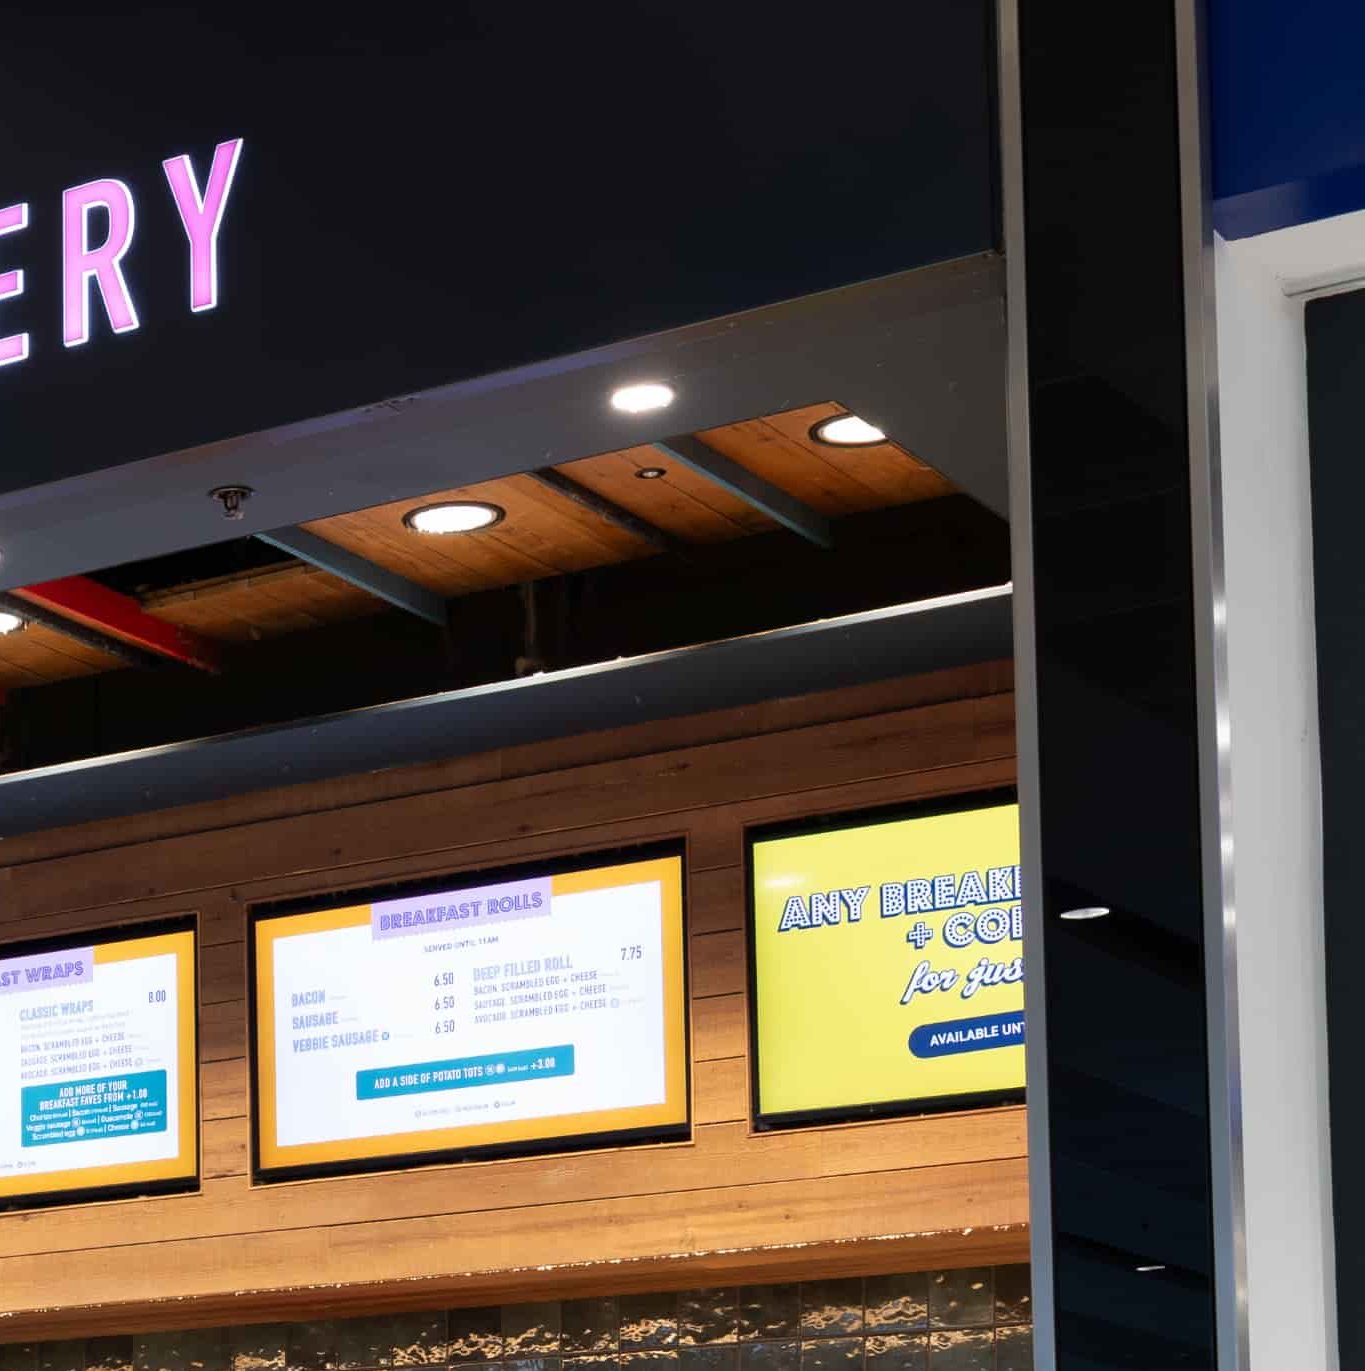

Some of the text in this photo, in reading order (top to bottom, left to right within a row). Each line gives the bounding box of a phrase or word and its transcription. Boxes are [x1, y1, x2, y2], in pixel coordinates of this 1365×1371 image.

[380, 891, 543, 931] BREAKFAST ROLLS
[778, 885, 870, 931] ANY
[907, 922, 933, 949] +
[25, 961, 84, 984] WRAPS
[473, 945, 642, 982] DEEP FILLED ROLL 7.75
[292, 972, 454, 1008] BACON 6.50
[900, 960, 959, 1005] for
[21, 1004, 57, 1021] CLASSIC
[60, 1000, 93, 1016] WRAPS
[293, 996, 455, 1030] SAUSAGE 6.50
[331, 1030, 379, 1048] SAUSAGE
[435, 1019, 455, 1034] 6.50
[930, 1024, 999, 1048] AVAILABLE
[59, 1080, 128, 1098] ADD MORE OF YOUR
[374, 1078, 390, 1089] ADD
[393, 1076, 398, 1087] A
[400, 1075, 419, 1087] SIDE
[420, 1073, 431, 1084] OF
[433, 1070, 461, 1082] POTATO
[464, 1067, 483, 1079] TOTS
[39, 1092, 124, 1112] BREAKFAST FAVES FROM
